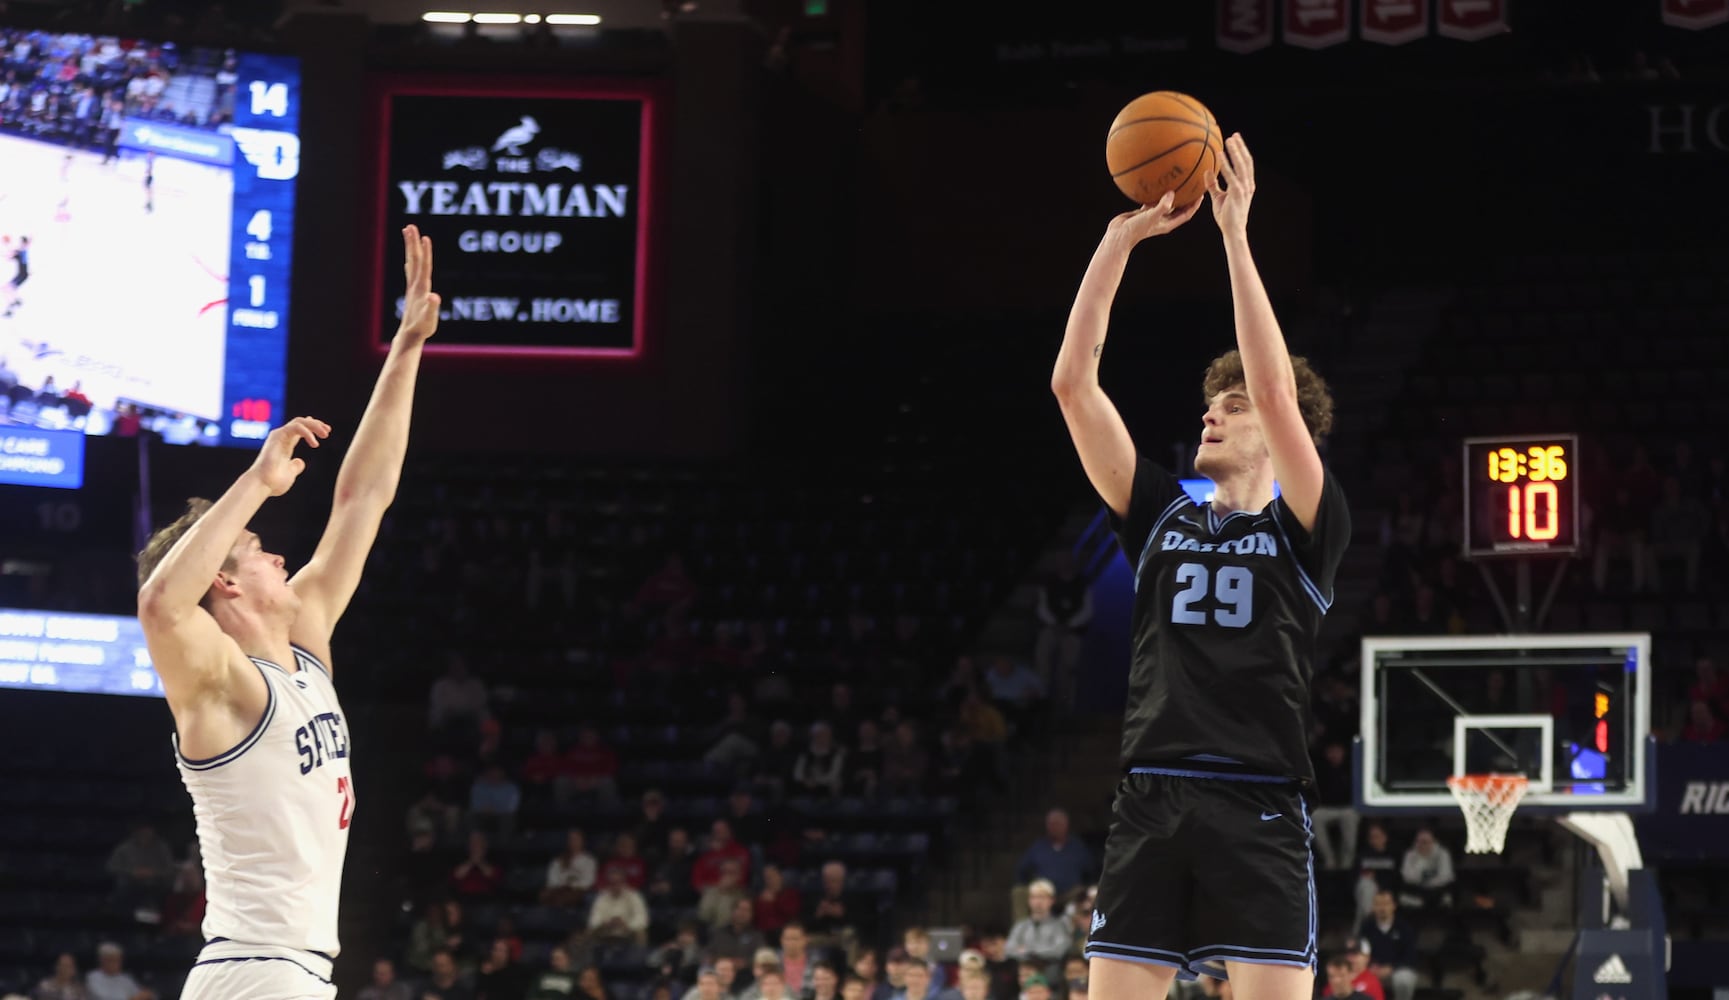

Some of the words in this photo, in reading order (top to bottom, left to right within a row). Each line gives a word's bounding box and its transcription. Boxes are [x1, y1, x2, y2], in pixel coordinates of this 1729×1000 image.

[249, 80, 289, 117] 14
[496, 156, 532, 174] THE
[397, 180, 629, 218] YEATMAN
[246, 208, 273, 241] 4
[458, 228, 563, 254] GROUP
[248, 274, 266, 307] 1
[1487, 445, 1568, 483] 13:36
[1508, 481, 1560, 540] 10
[1171, 562, 1254, 629] 29
